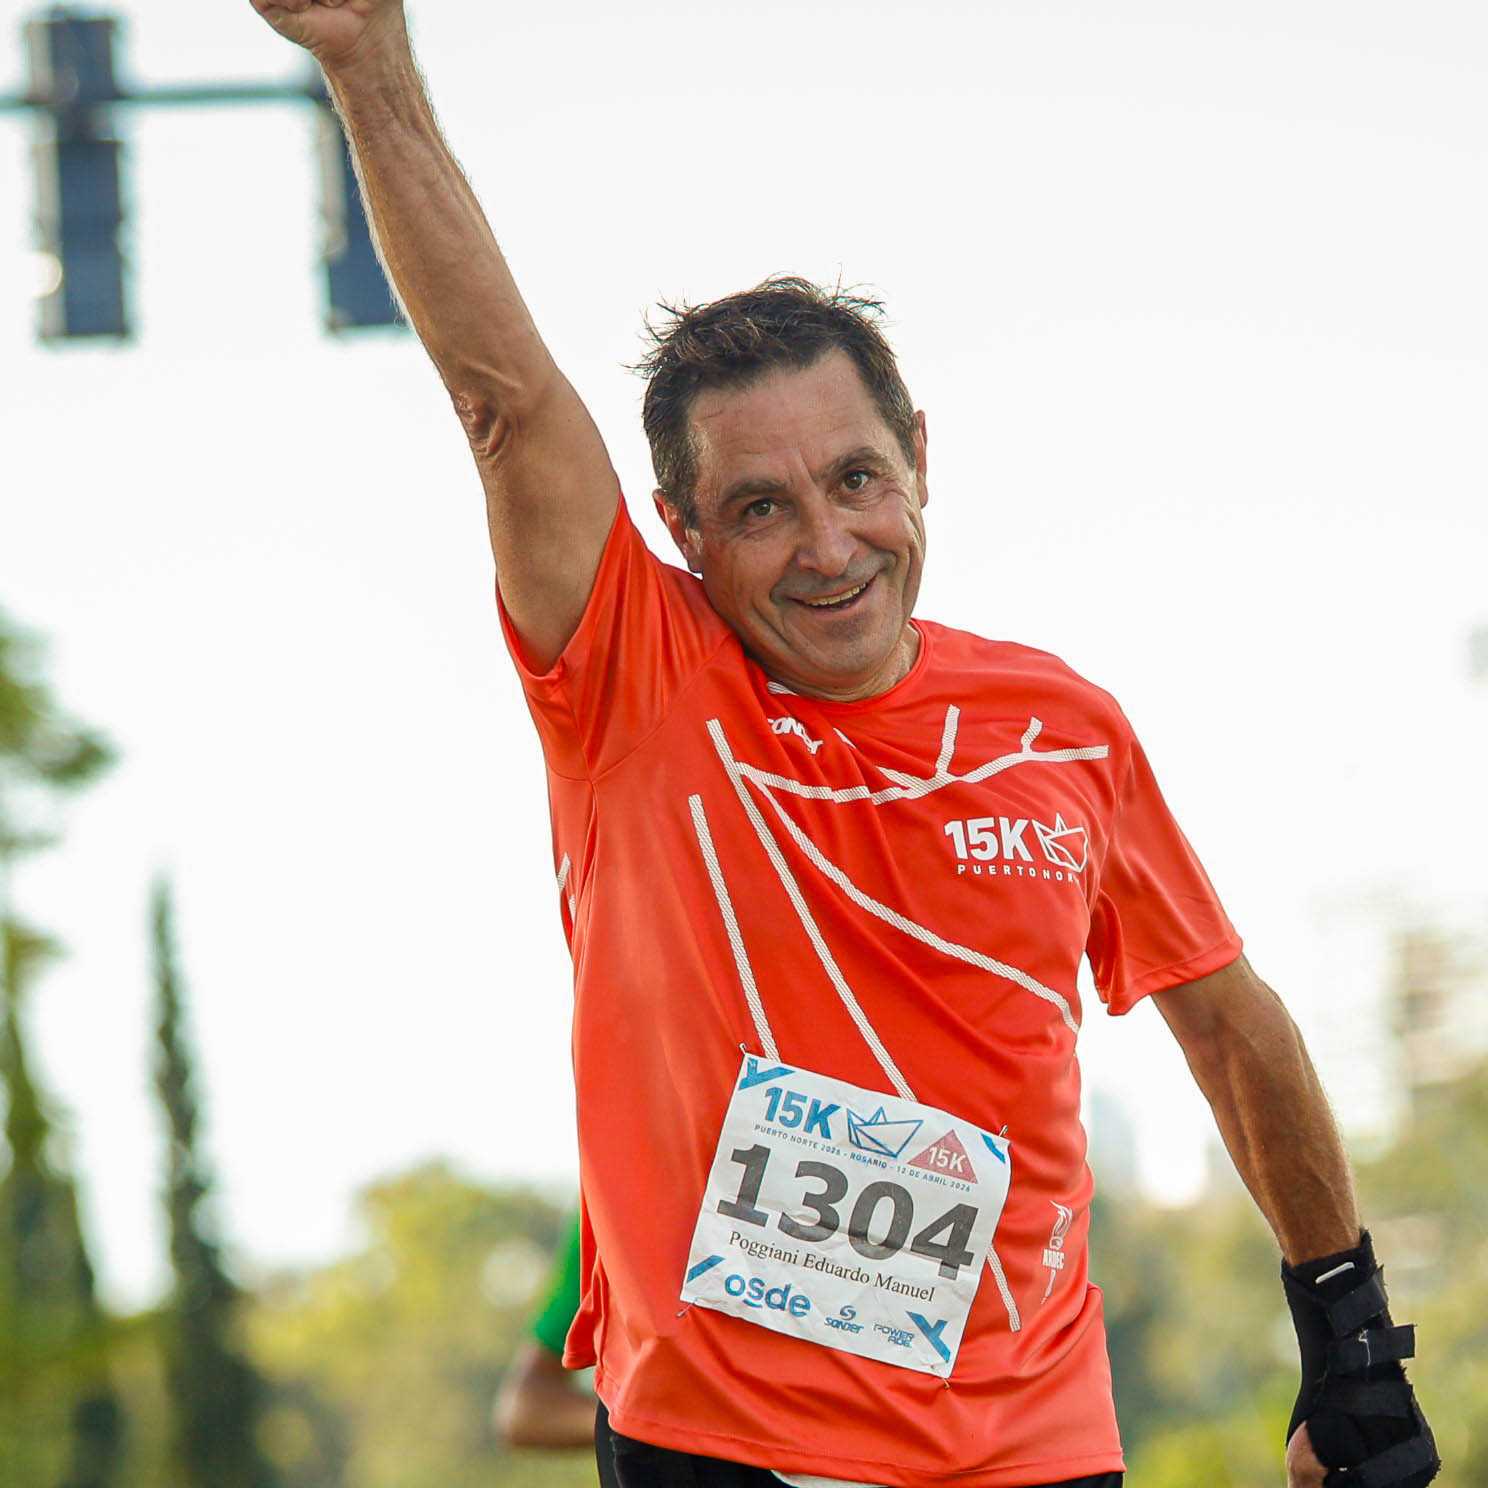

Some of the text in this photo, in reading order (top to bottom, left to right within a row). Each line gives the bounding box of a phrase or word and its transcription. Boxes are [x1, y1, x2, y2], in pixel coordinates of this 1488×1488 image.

[944, 816, 1034, 862] 15K
[764, 1086, 841, 1140] 15K
[754, 1124, 788, 1140] PUERTO
[790, 1135, 818, 1149] NORTE
[850, 1152, 887, 1169] ROSARIO
[909, 1169, 920, 1178] DE
[922, 1173, 947, 1186] ABRIL
[928, 1146, 966, 1174] 15K
[716, 1143, 979, 1281] 1304
[729, 1231, 936, 1302] Poggiani Eduardo Manuel
[724, 1273, 811, 1318] osde
[873, 1323, 914, 1342] POWER
